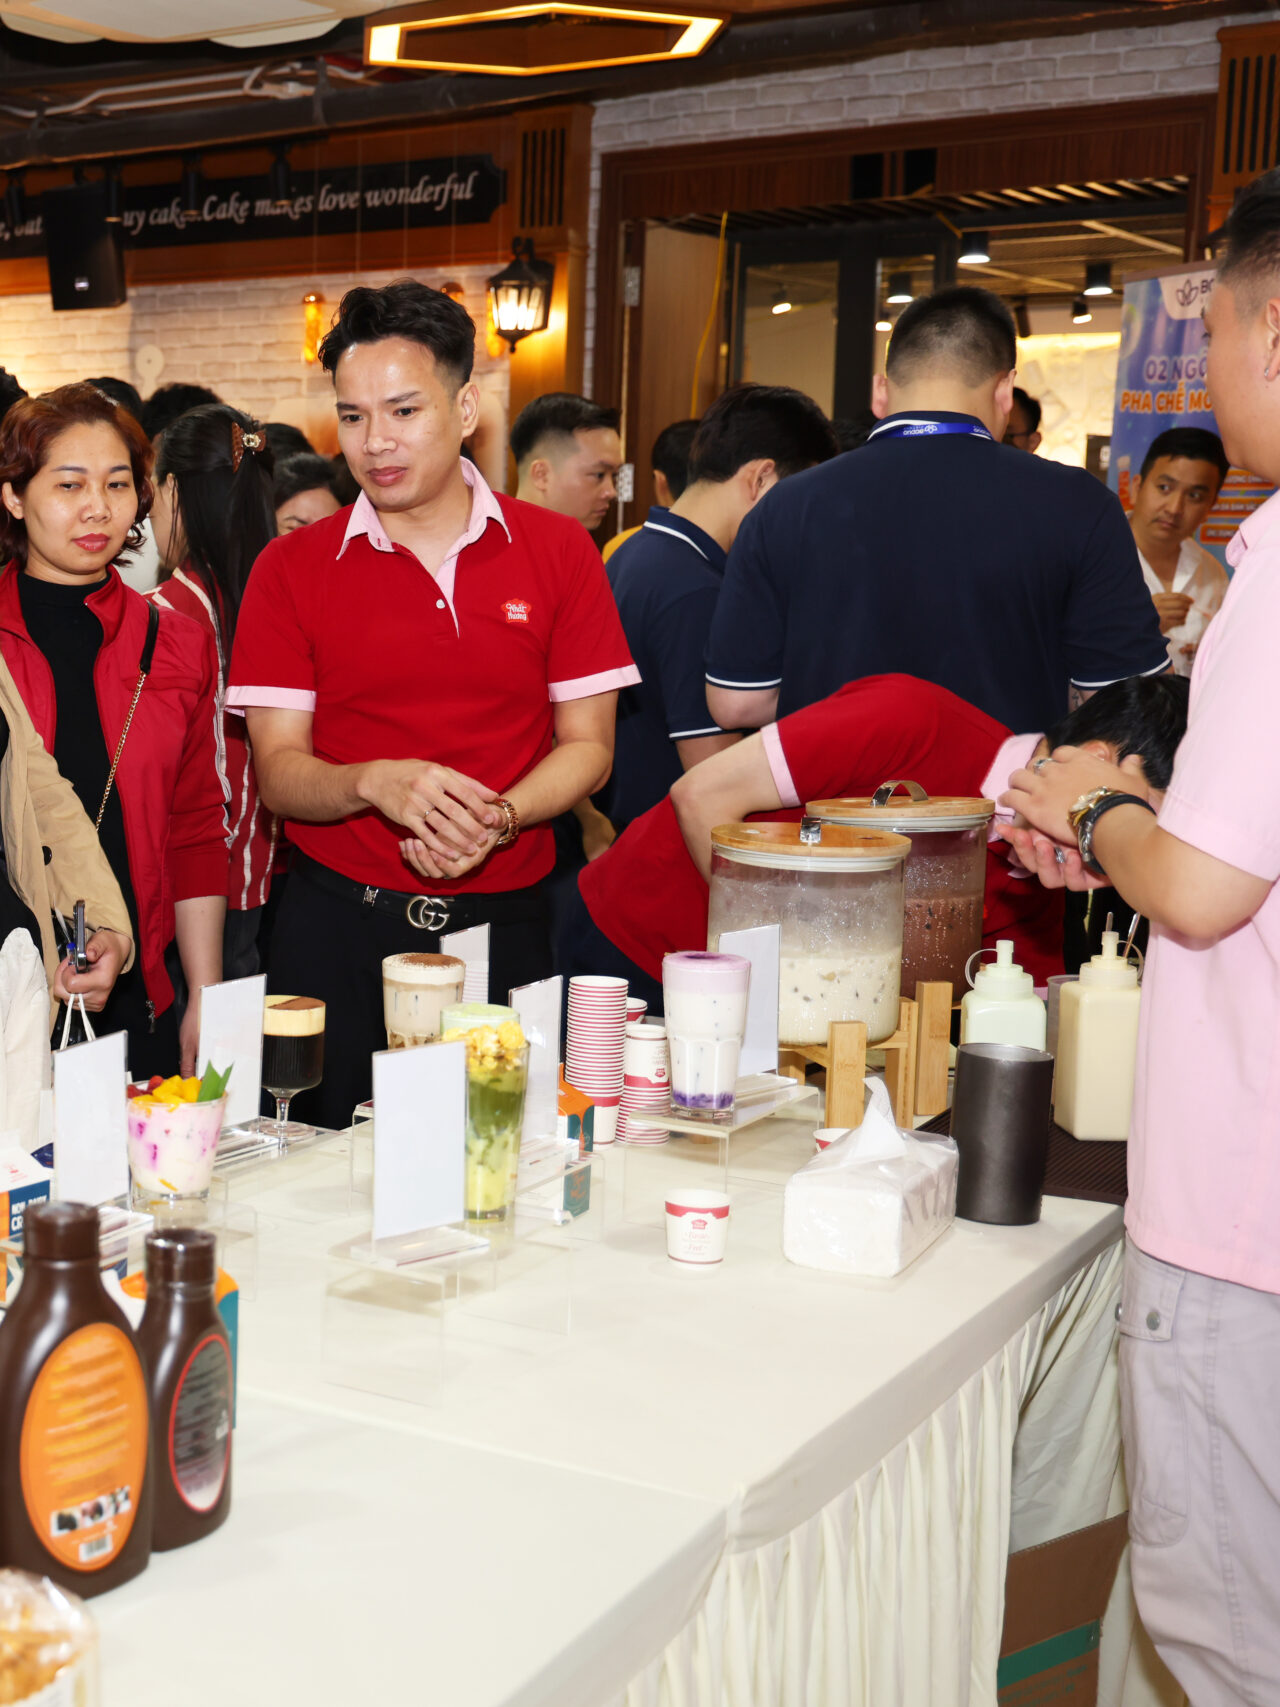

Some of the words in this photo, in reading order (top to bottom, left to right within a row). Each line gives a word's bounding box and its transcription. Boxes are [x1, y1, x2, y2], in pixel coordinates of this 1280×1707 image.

[318, 183, 361, 212] love
[365, 170, 479, 212] wonderful
[1120, 390, 1153, 412] PHA
